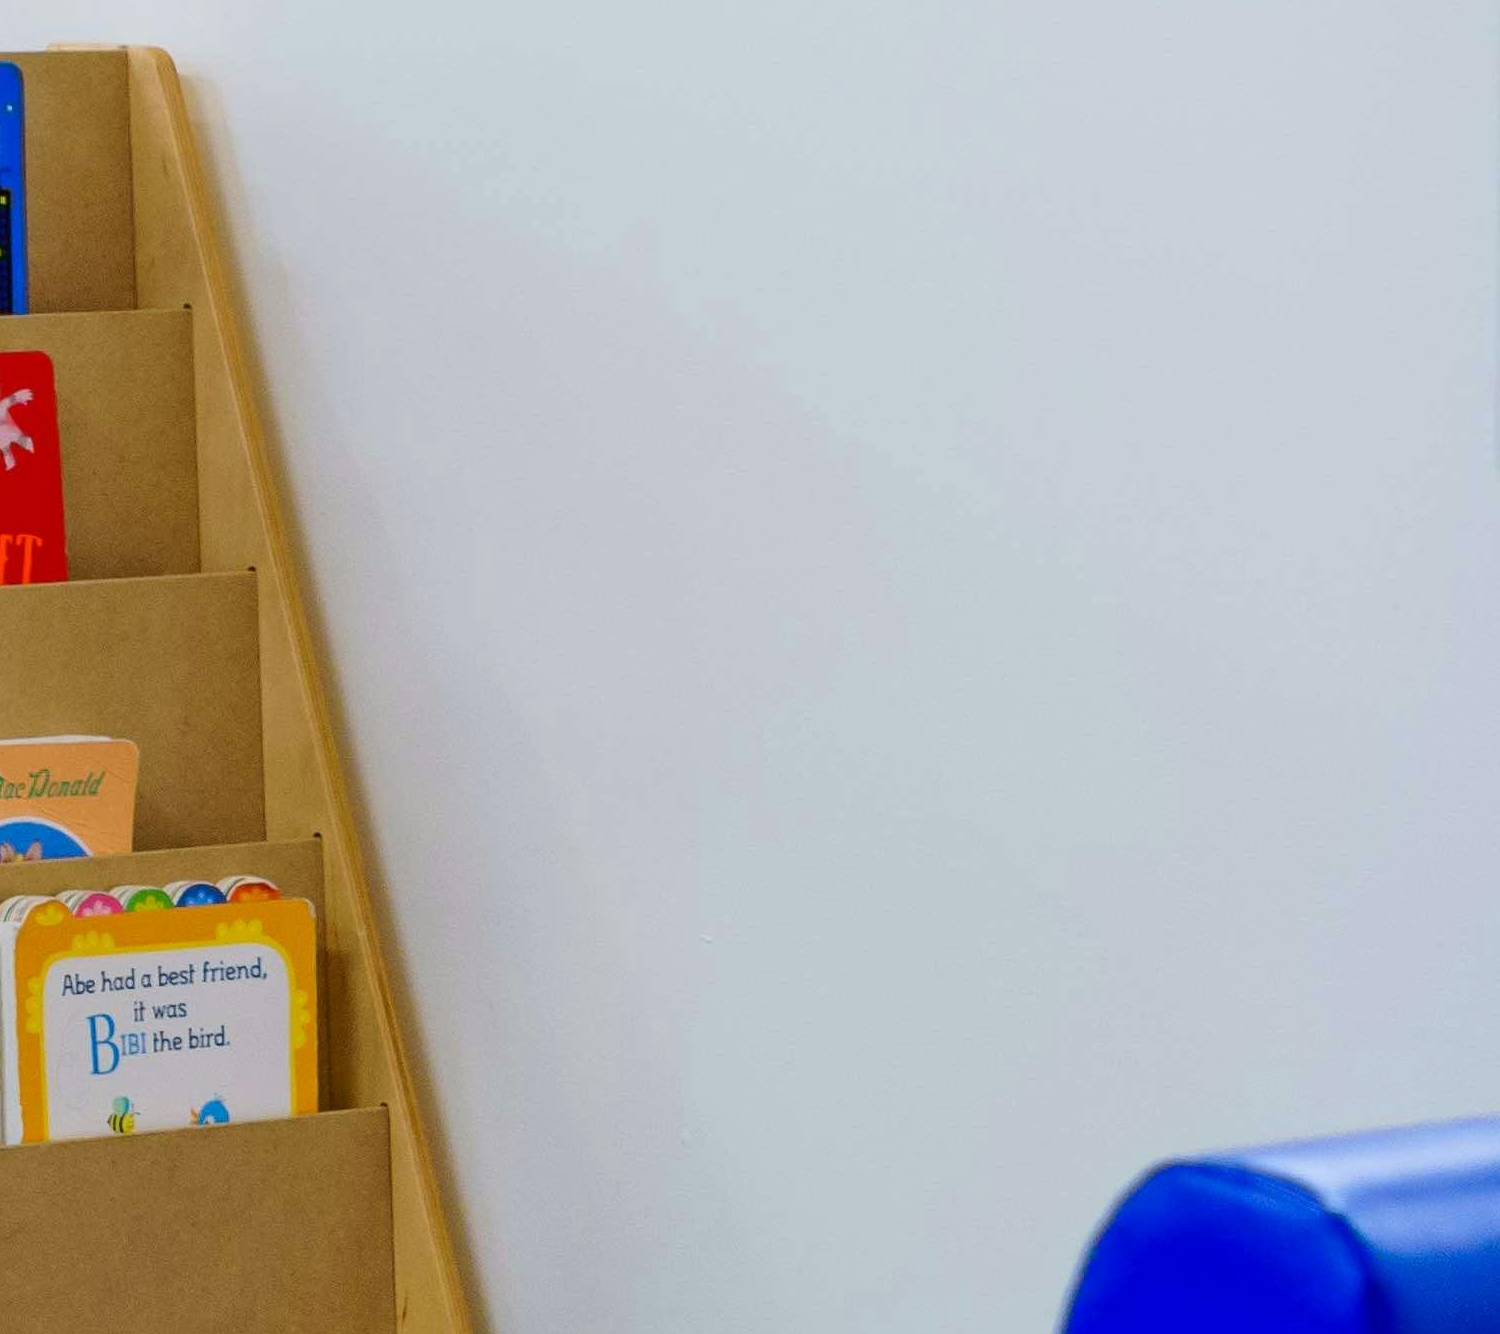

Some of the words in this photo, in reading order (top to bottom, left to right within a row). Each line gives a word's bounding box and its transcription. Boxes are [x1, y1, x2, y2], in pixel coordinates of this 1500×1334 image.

[62, 972, 96, 997] Abe
[101, 968, 136, 993] had
[142, 973, 153, 988] a
[158, 965, 196, 988] best
[202, 957, 269, 983] friend,
[133, 1000, 148, 1022] it
[152, 1000, 188, 1020] was
[153, 1029, 183, 1052] the
[188, 1025, 230, 1048] bird.
